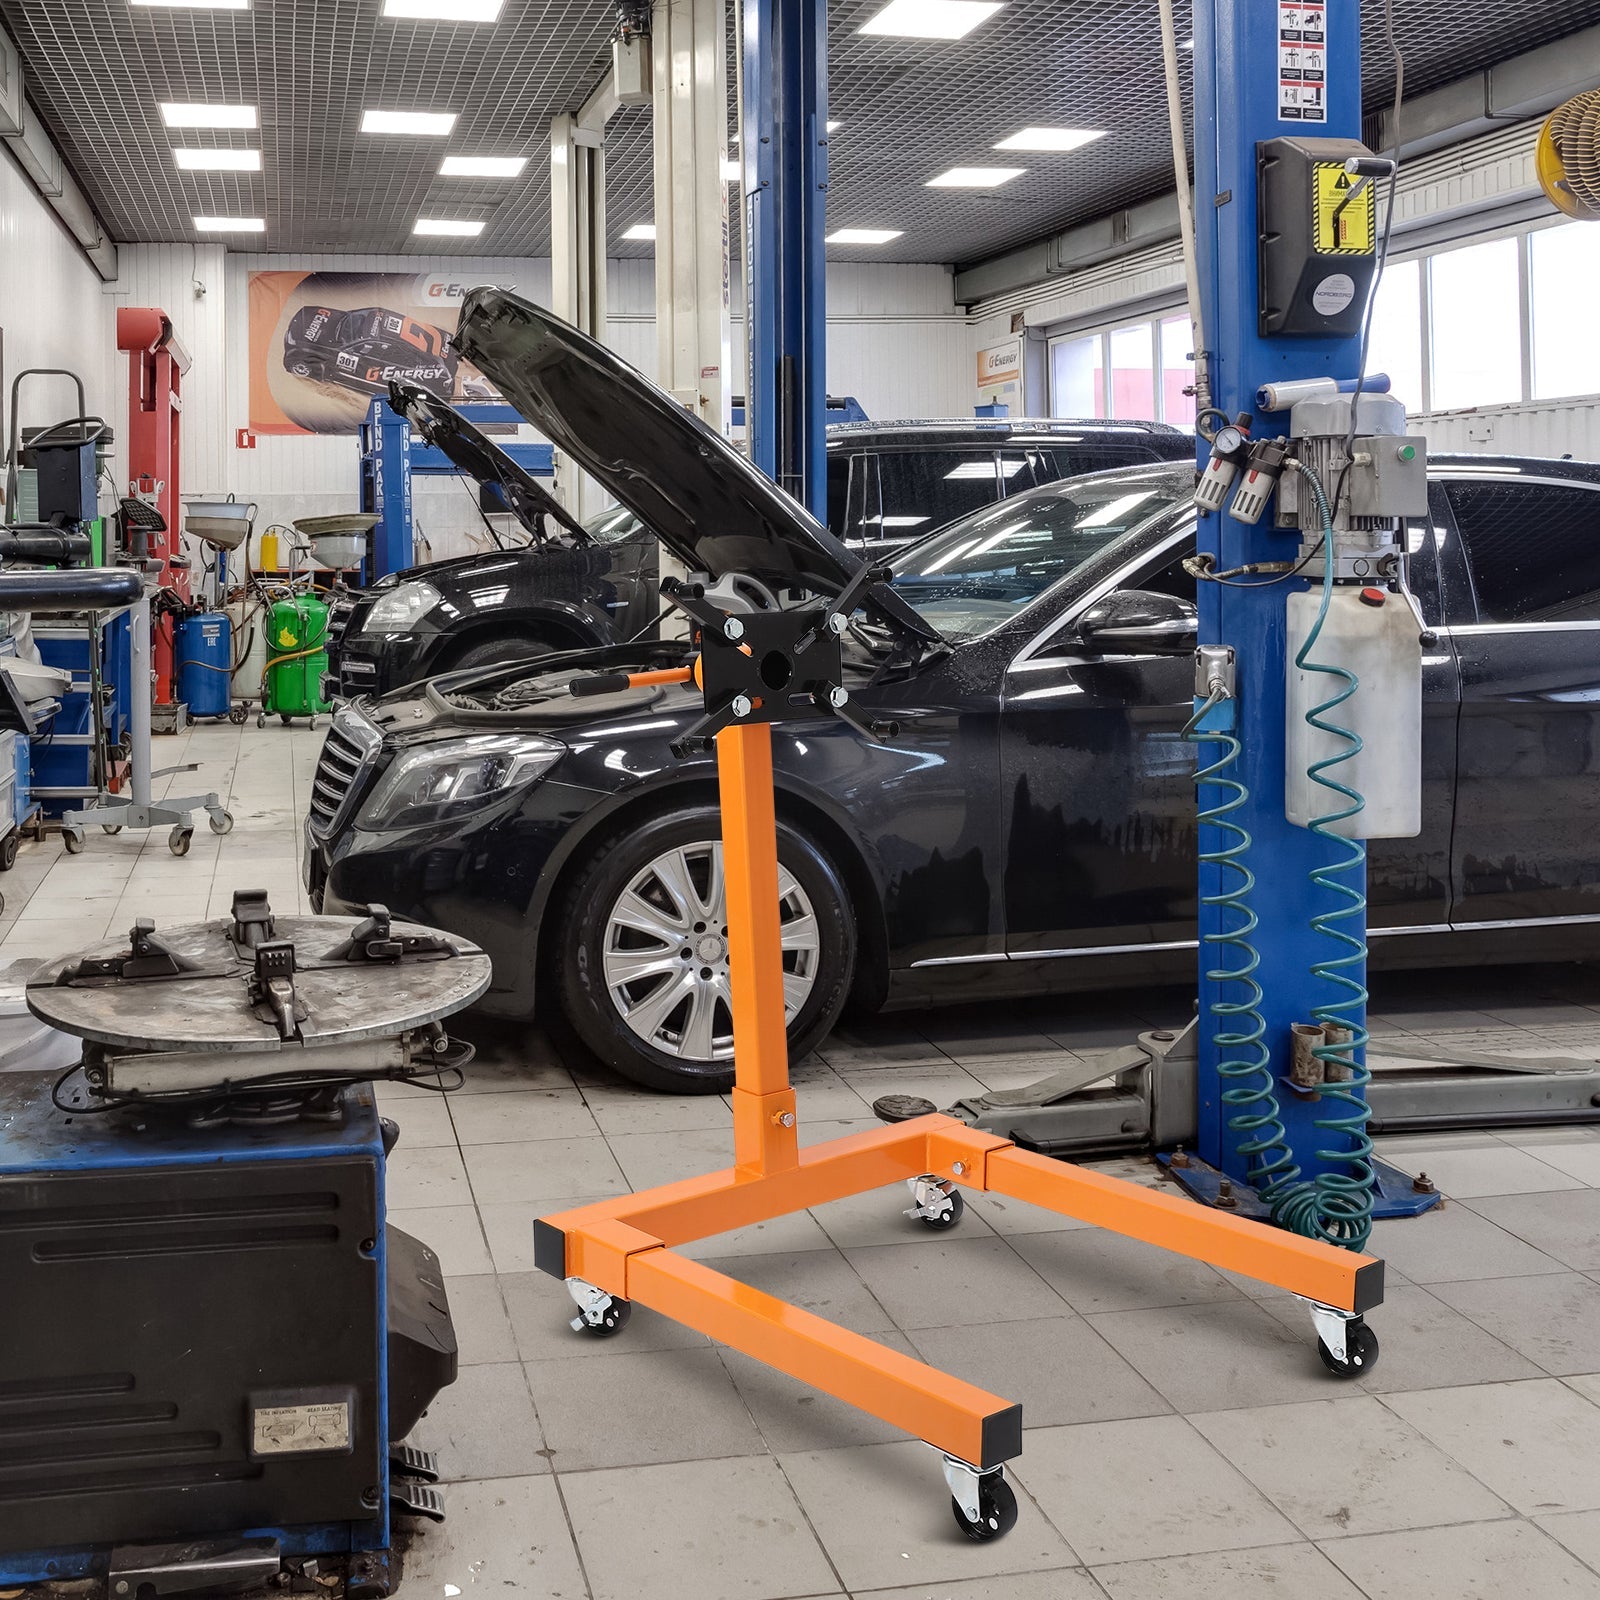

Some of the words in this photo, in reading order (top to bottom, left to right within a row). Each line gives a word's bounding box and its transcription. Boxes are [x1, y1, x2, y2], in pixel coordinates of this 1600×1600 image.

[339, 356, 357, 369] 301
[375, 458, 384, 496] PAK
[403, 458, 411, 496] PAK
